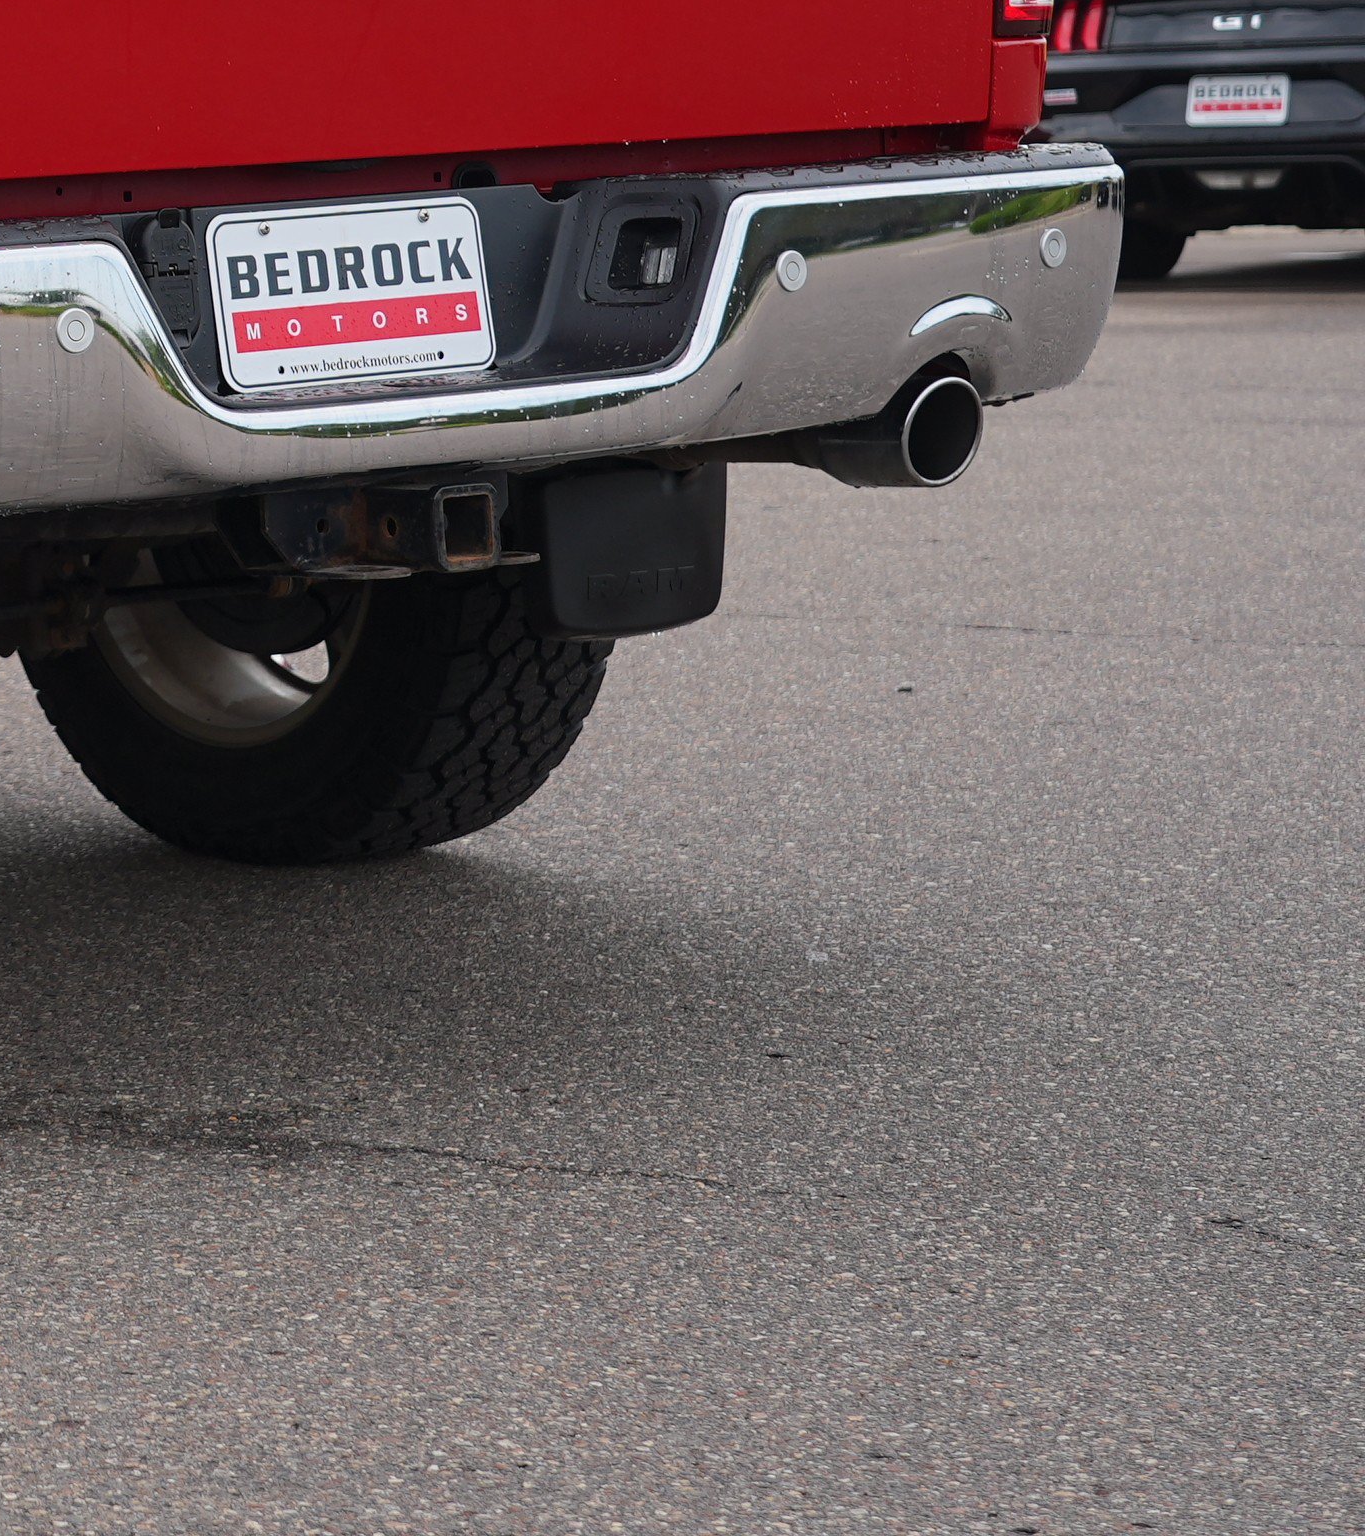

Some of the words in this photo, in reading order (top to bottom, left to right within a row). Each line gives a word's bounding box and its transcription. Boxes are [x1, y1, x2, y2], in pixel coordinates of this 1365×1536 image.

[1195, 84, 1281, 98] BEDROCK
[226, 237, 473, 300] BEDROCK
[245, 303, 469, 340] MOTORS
[290, 350, 437, 375] www.bedrockmotors.com
